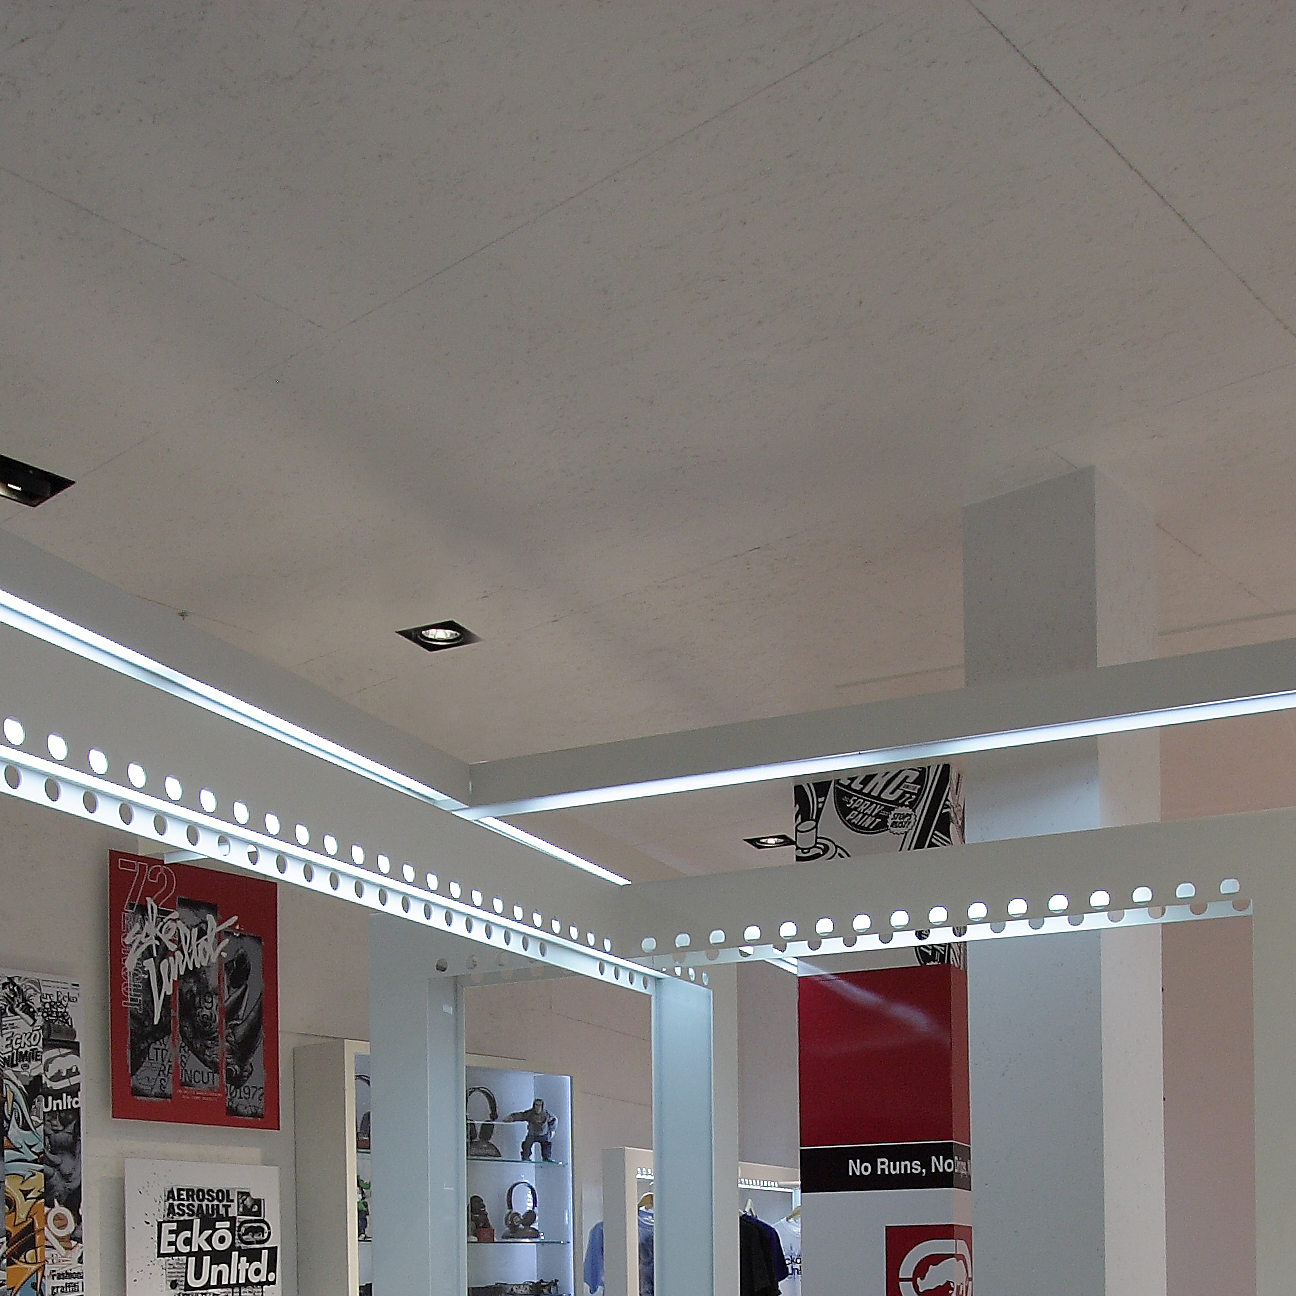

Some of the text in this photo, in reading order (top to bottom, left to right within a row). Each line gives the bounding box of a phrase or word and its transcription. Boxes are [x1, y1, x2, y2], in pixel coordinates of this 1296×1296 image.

[846, 796, 883, 816] SPRAY
[846, 810, 882, 829] PAINT
[118, 858, 177, 918] 72
[848, 1158, 872, 1176] No
[876, 1157, 926, 1177] Runs,
[931, 1155, 954, 1173] No
[166, 1187, 235, 1204] AEROSOL
[166, 1202, 232, 1218] ASSAULT
[159, 1218, 233, 1255] Eckō
[186, 1249, 277, 1288] Unltd.
